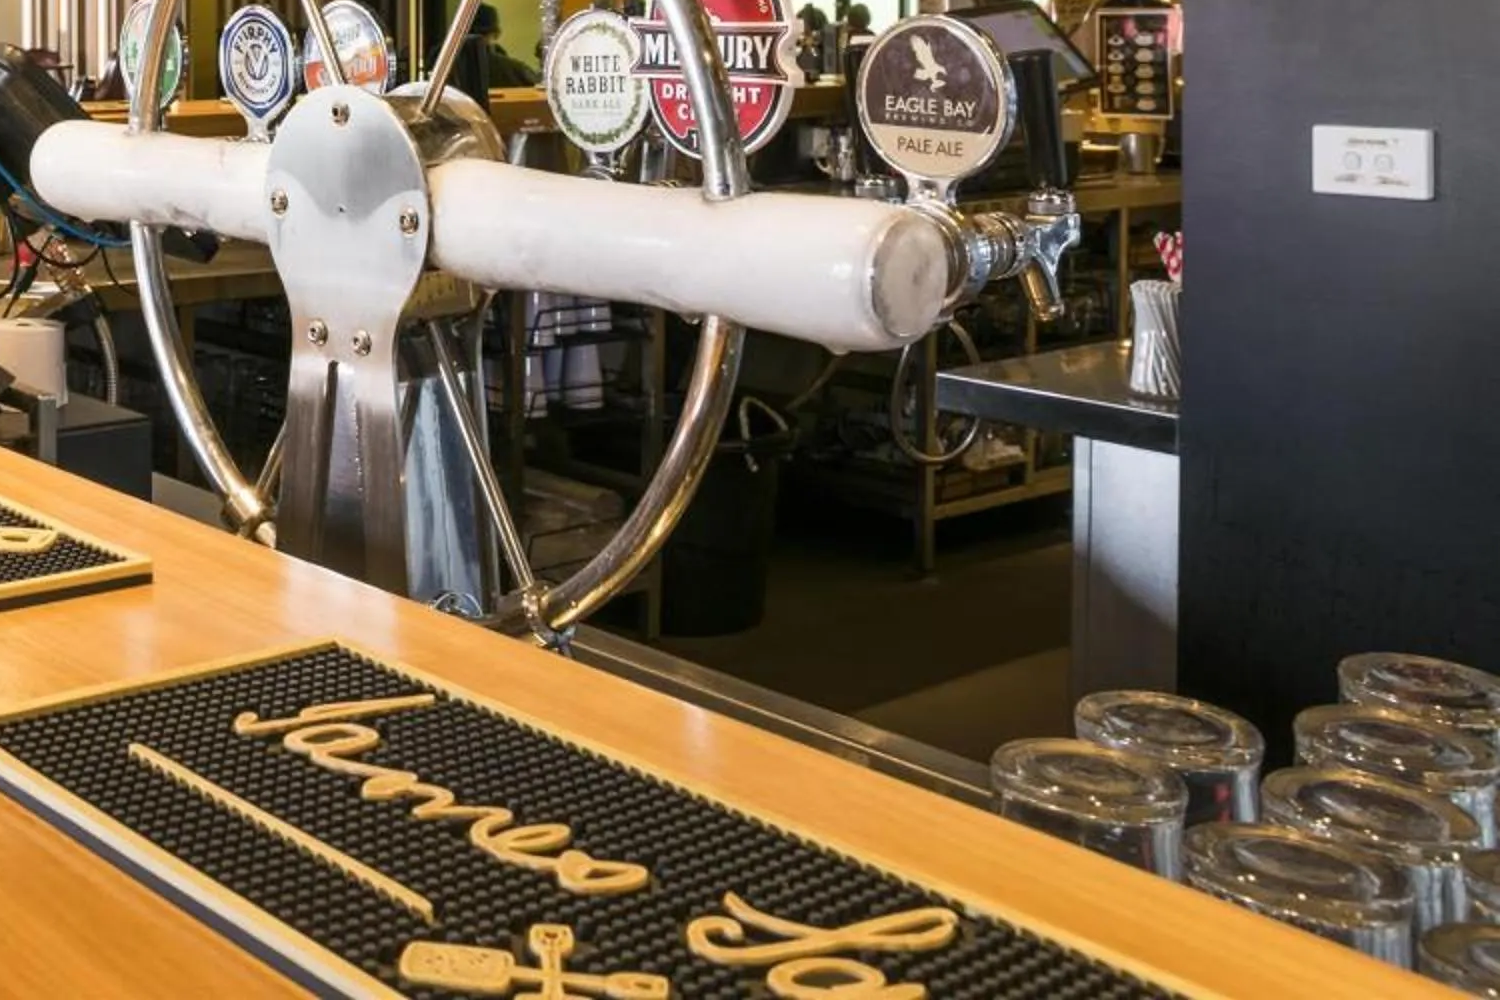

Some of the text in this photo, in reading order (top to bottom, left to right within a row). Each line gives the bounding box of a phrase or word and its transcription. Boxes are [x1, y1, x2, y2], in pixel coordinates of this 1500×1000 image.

[644, 33, 773, 69] MEURY
[570, 55, 621, 73] WHITE
[565, 76, 626, 95] RABBIT
[661, 83, 761, 104] DRHT
[884, 95, 976, 118] EAGLE BAY
[896, 136, 964, 157] PALE ALE
[233, 693, 649, 895] James
